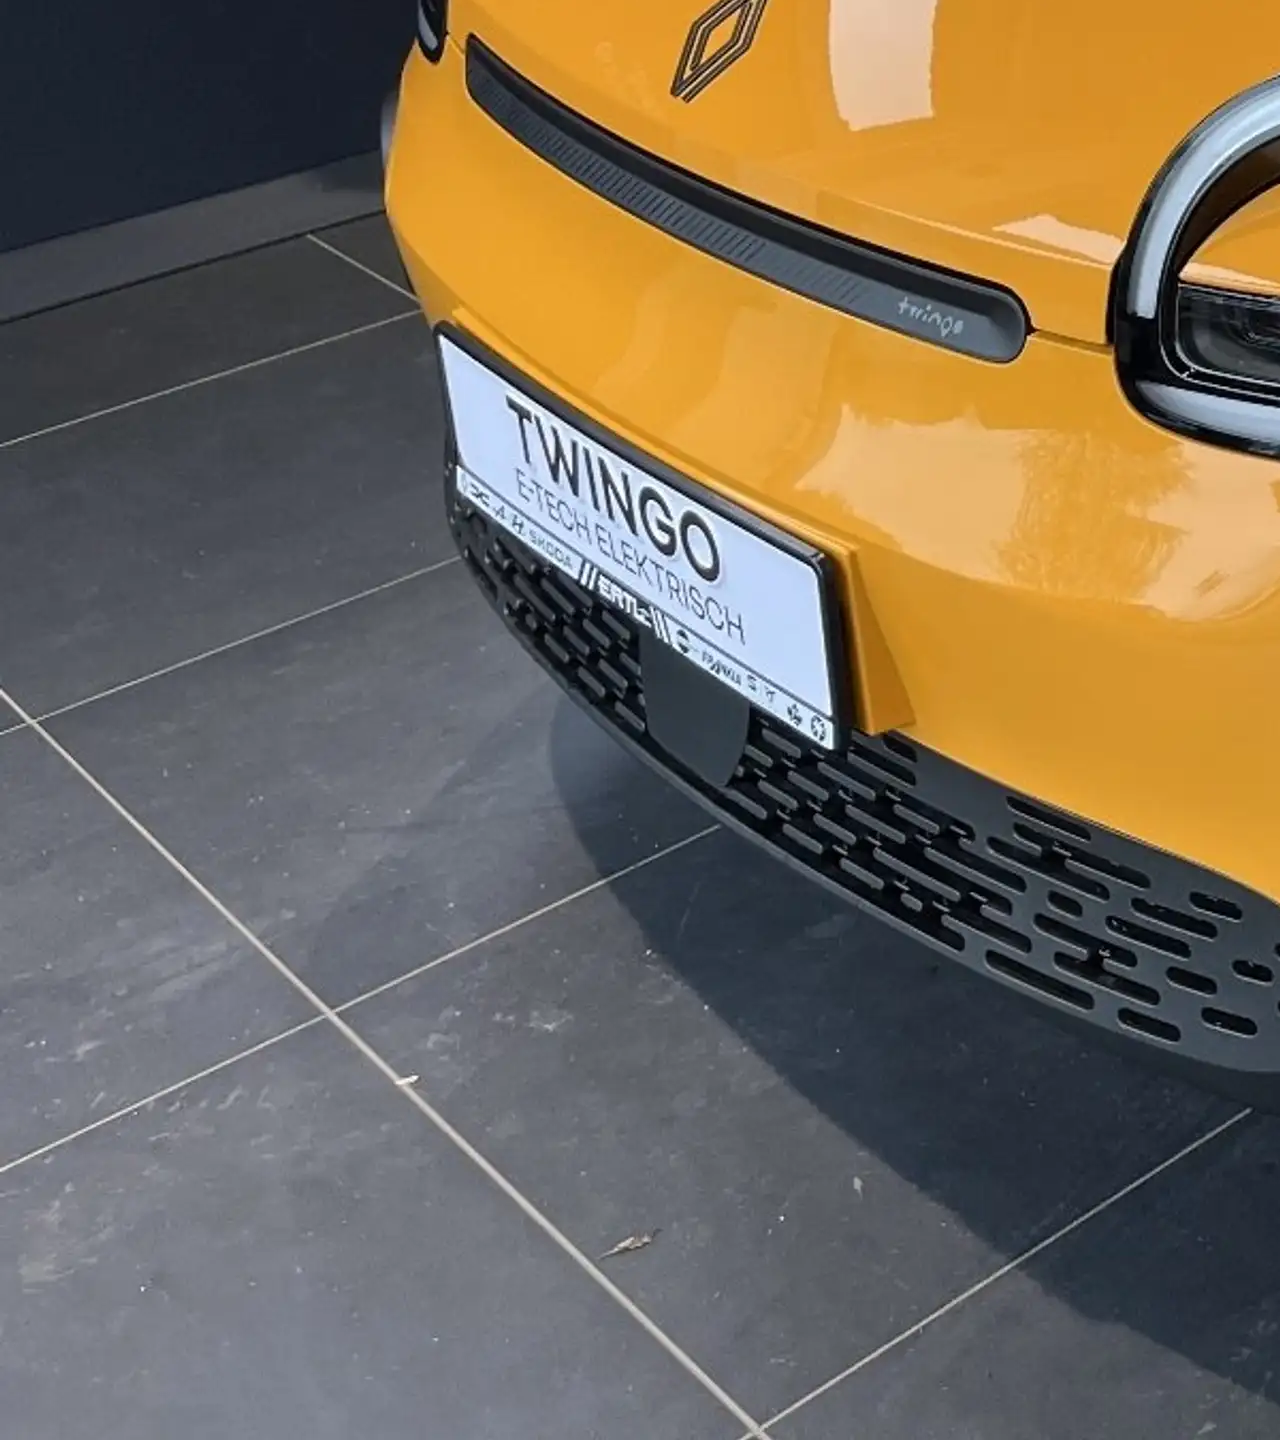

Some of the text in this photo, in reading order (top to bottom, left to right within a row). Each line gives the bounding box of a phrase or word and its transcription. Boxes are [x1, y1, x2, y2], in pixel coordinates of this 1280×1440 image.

[898, 296, 964, 339] twingo
[505, 394, 721, 583] TWINGO
[515, 467, 747, 647] E-TECH ELEKTRISCH
